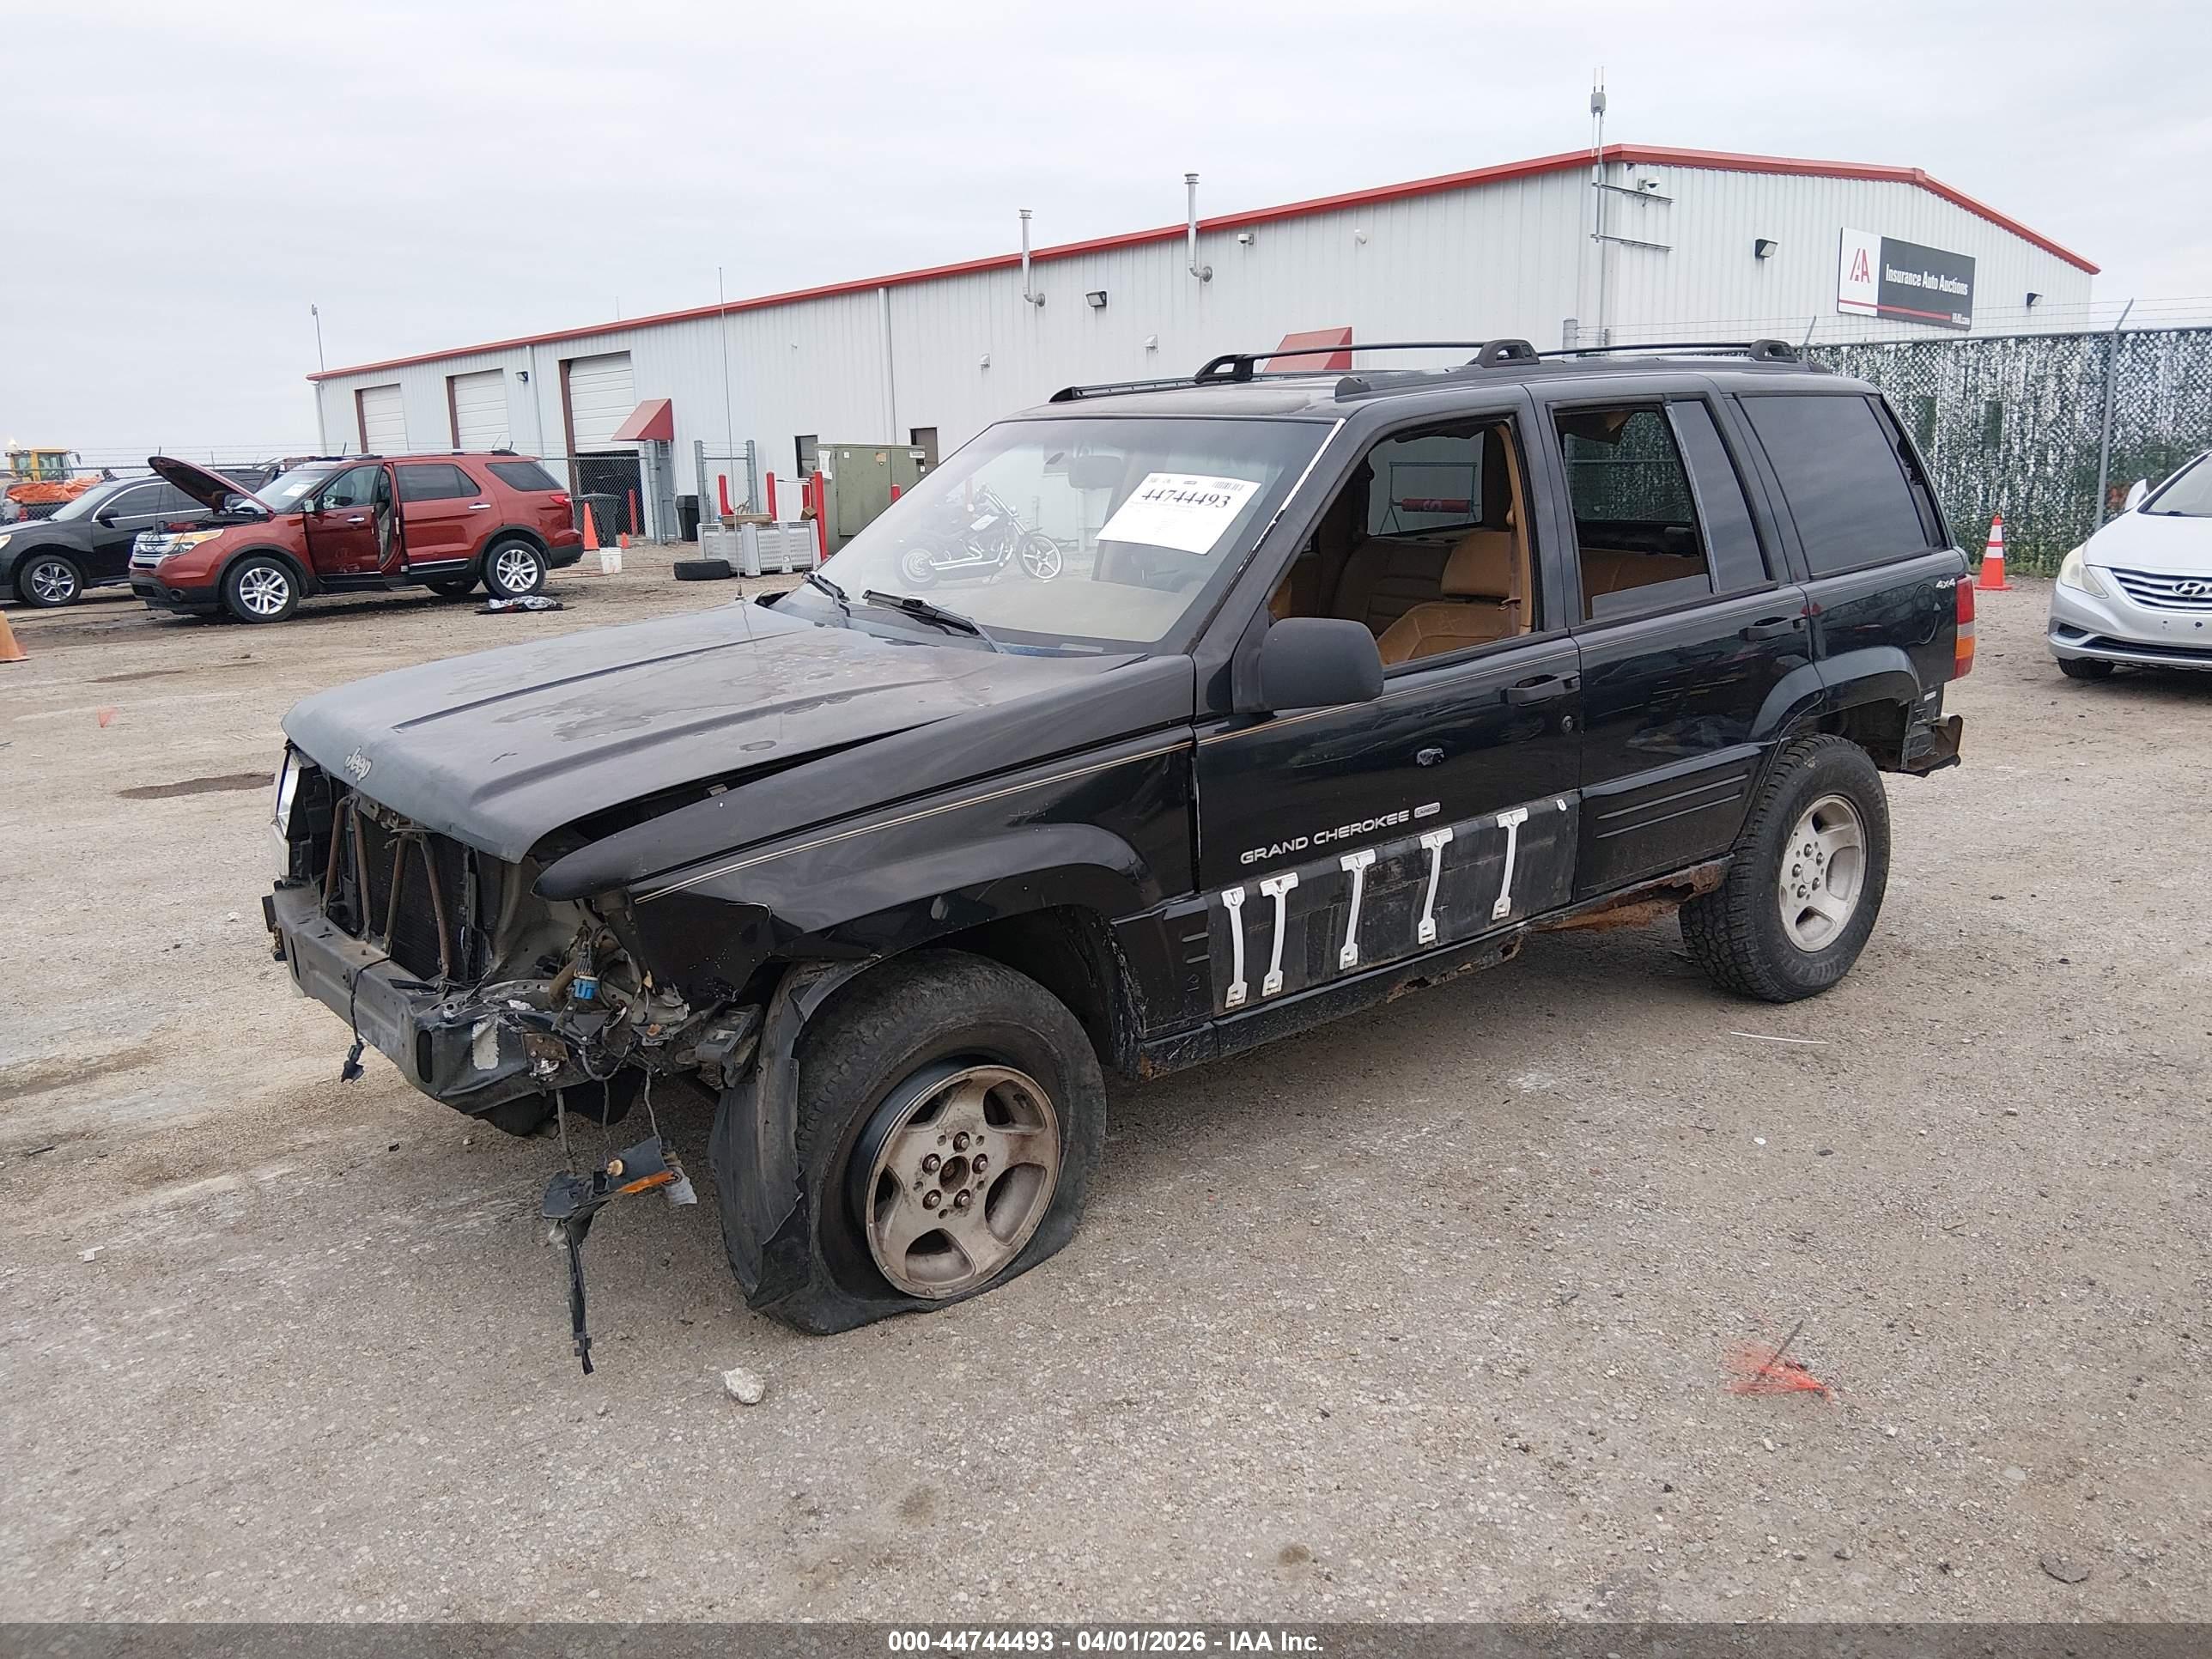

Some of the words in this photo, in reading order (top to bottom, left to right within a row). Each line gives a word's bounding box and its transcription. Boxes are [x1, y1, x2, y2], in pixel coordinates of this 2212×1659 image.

[1886, 264, 1921, 286] Insurance
[1923, 271, 1938, 289] Auto
[1939, 275, 1968, 295] Auctions
[1142, 489, 1231, 507] 44744493
[345, 746, 372, 781] Jeep
[1241, 837, 1308, 864] GRAND
[1313, 810, 1409, 844] CHEROKEE
